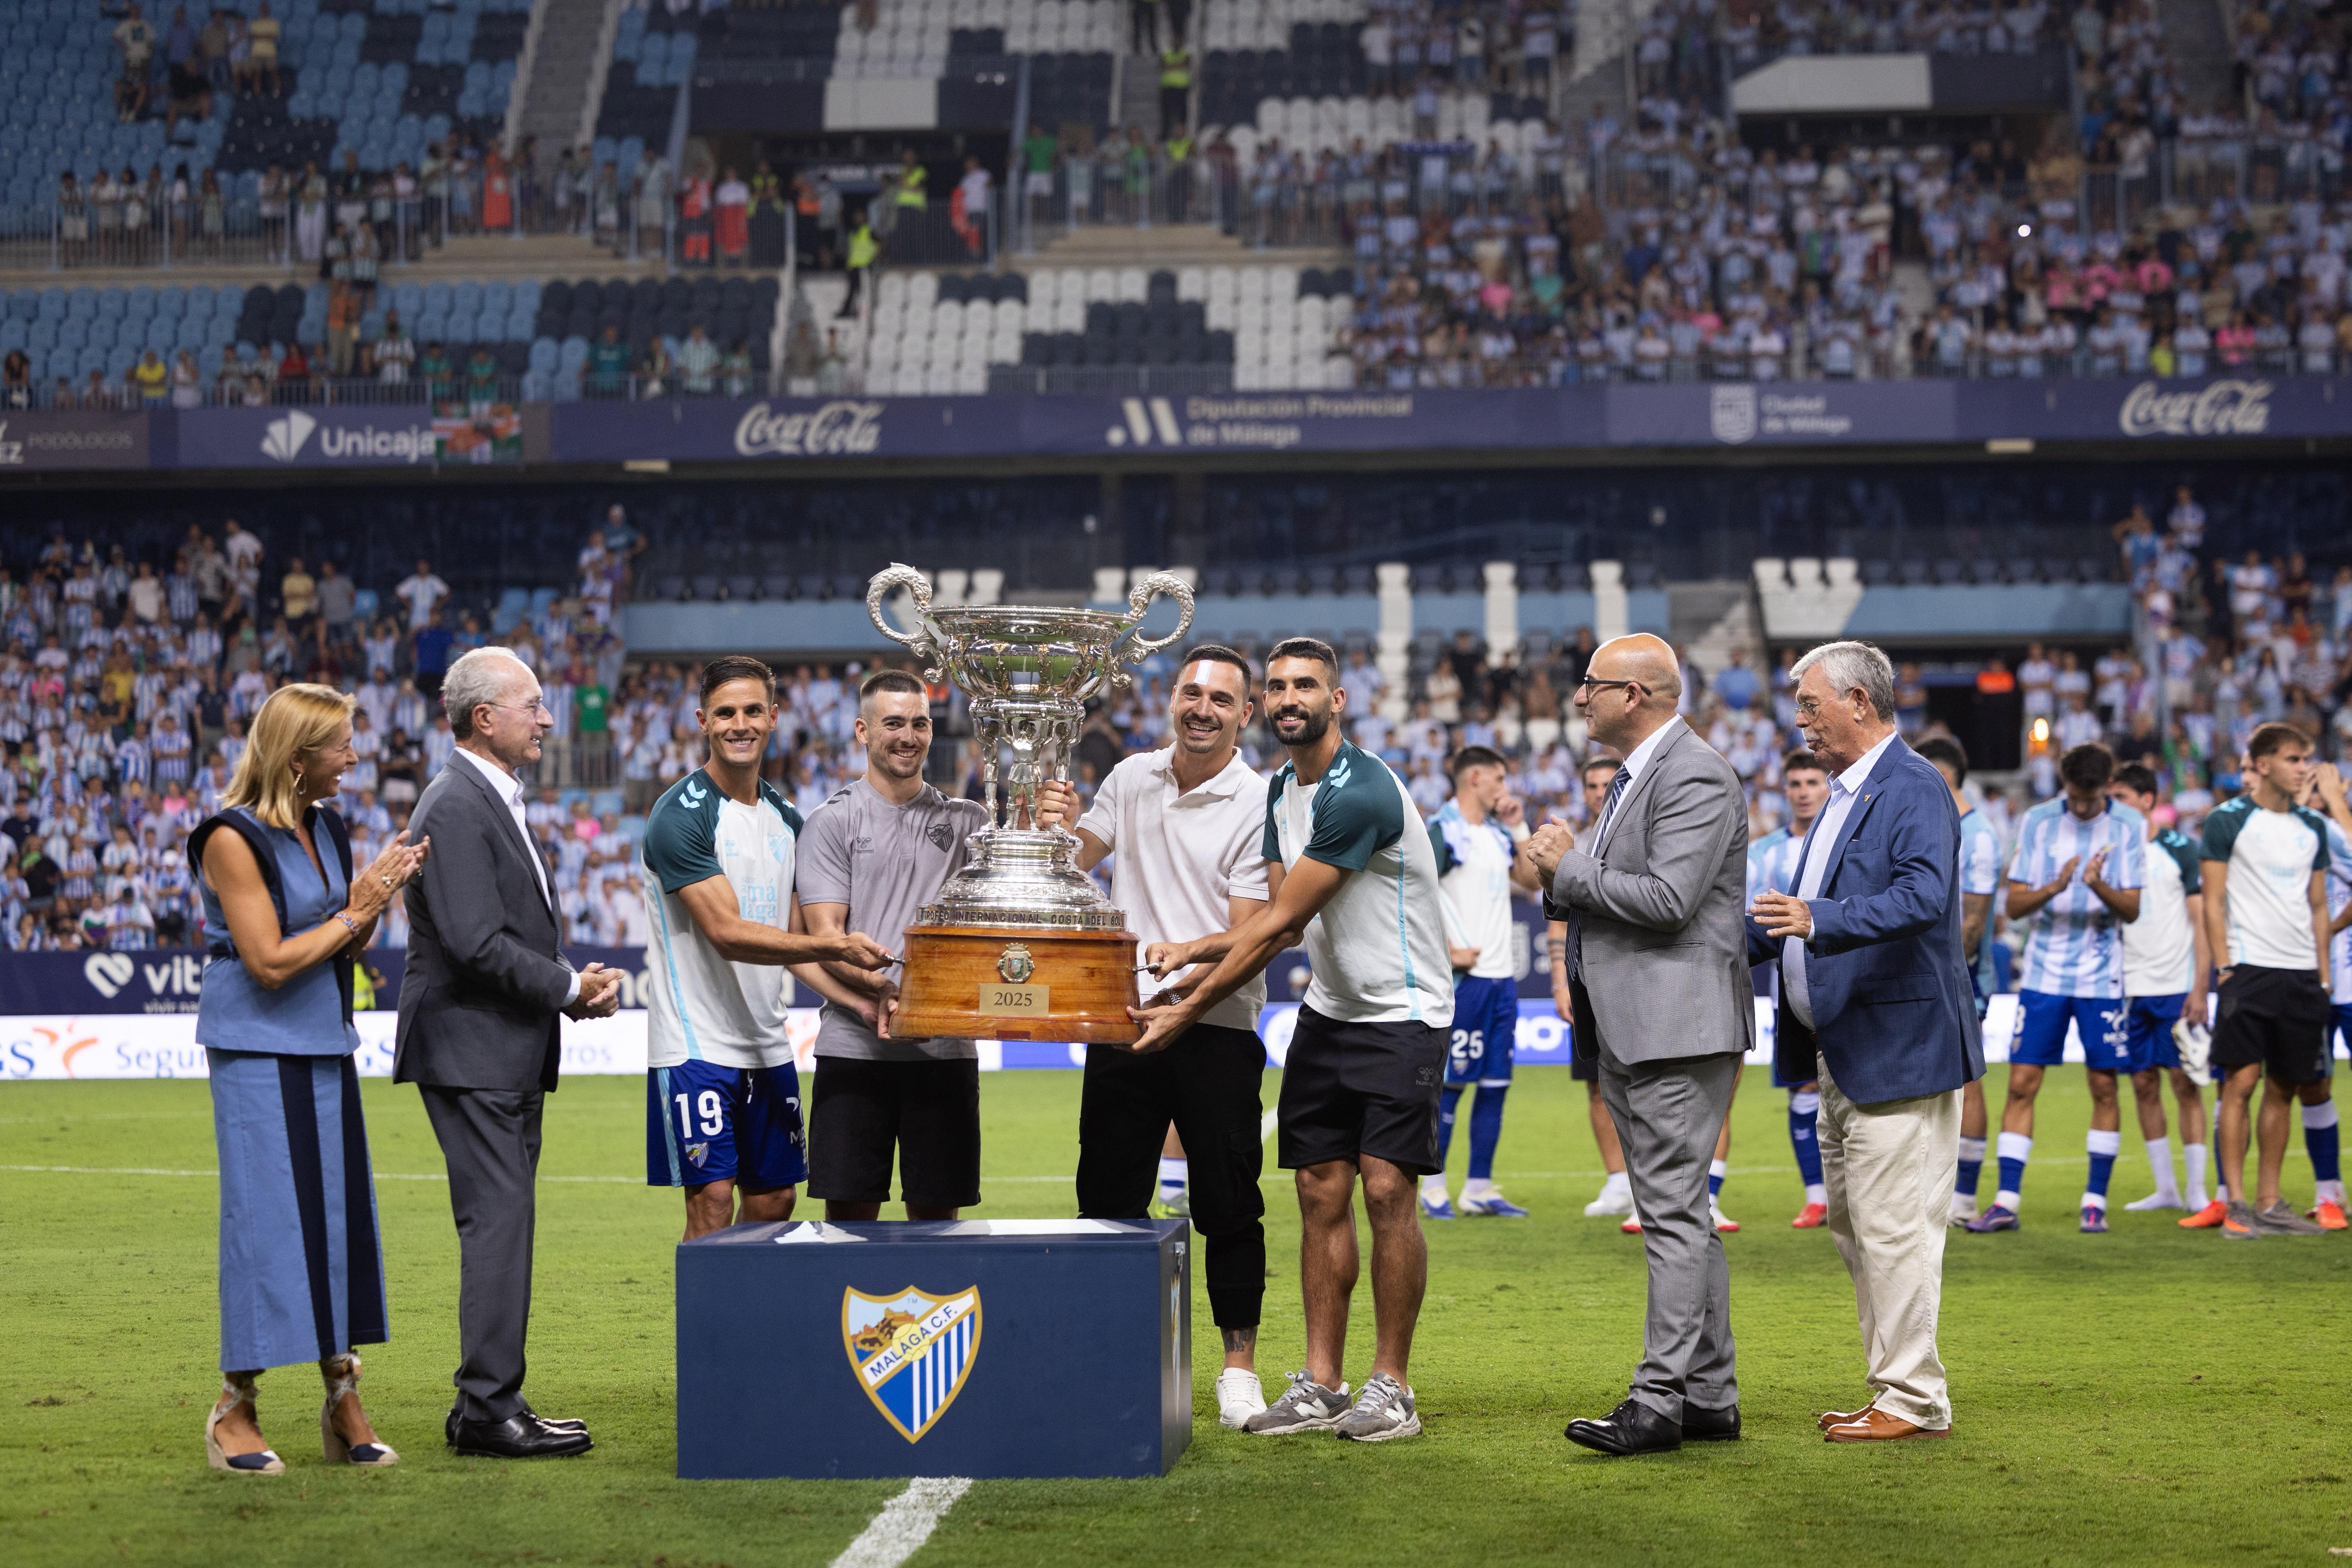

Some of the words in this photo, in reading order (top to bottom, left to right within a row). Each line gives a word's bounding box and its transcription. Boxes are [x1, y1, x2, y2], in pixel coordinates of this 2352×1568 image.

[322, 425, 436, 464] Unicaja
[924, 910, 950, 920] TROFEO
[956, 911, 1041, 924] INTERNACIONAL
[1051, 914, 1083, 925] COSTA
[1091, 915, 1106, 926] DEL
[1110, 915, 1121, 926] SOL
[994, 992, 1032, 1007] 2025
[1450, 1029, 1484, 1060] 25
[675, 1090, 724, 1139] 19
[870, 1326, 932, 1377] MALAGA
[931, 1305, 958, 1328] C.F.
